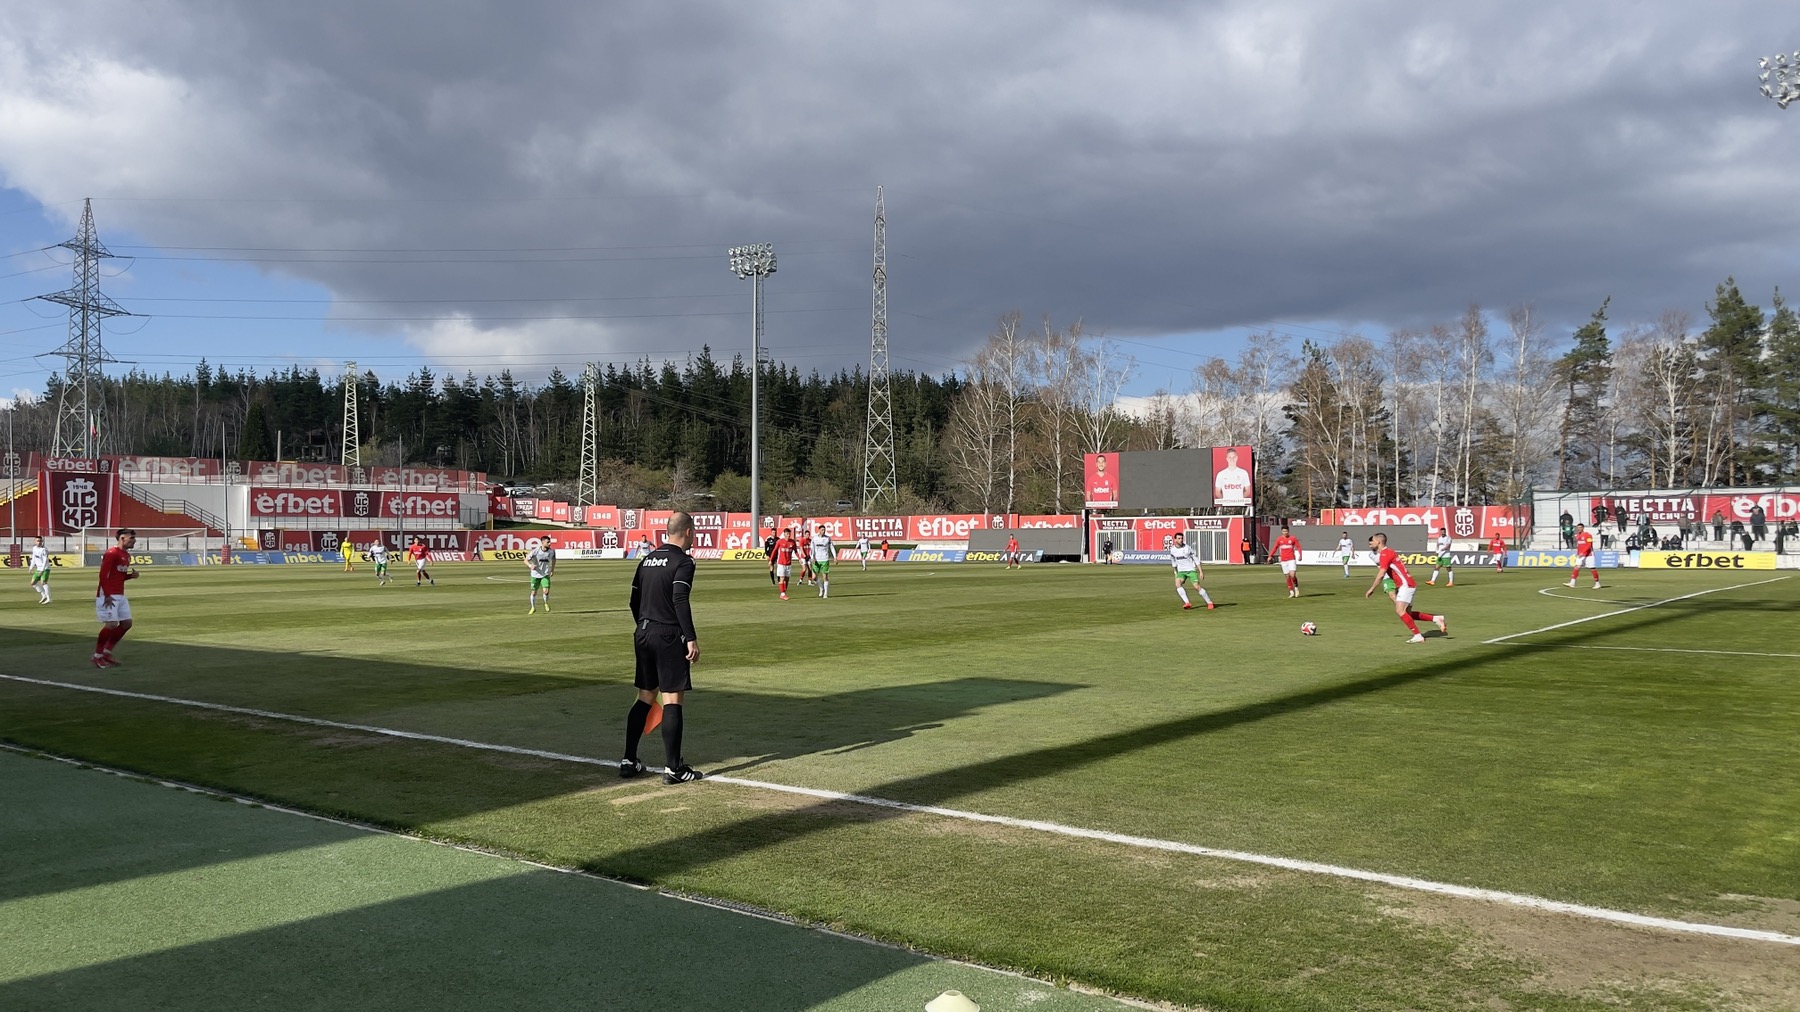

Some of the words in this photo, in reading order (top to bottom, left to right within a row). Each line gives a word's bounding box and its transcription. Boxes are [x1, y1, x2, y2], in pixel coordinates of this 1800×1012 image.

[46, 458, 93, 471] efbet
[260, 463, 337, 483] efbet
[378, 468, 448, 486] efbet
[254, 492, 334, 514] efbet
[388, 496, 456, 516] efbet
[1731, 494, 1800, 518] efb
[592, 512, 612, 520] 1948
[691, 515, 722, 526] СТТА
[1491, 516, 1526, 527] 1948
[1652, 512, 1695, 521] ВСИЧО
[732, 520, 751, 528] 1948
[855, 518, 903, 531] ЧЕСТТА
[917, 516, 979, 537] efbet
[1144, 520, 1176, 529] efbet
[564, 541, 591, 549] 1948
[282, 552, 325, 564] inbet
[734, 549, 767, 560] efbet
[908, 548, 944, 561] inbet
[965, 551, 1000, 561] efbet
[1000, 552, 1034, 561] ЛГА
[1399, 553, 1438, 565] efbe
[1516, 551, 1577, 568] inbet
[1664, 553, 1745, 568] efbet
[643, 556, 669, 567] inbet
